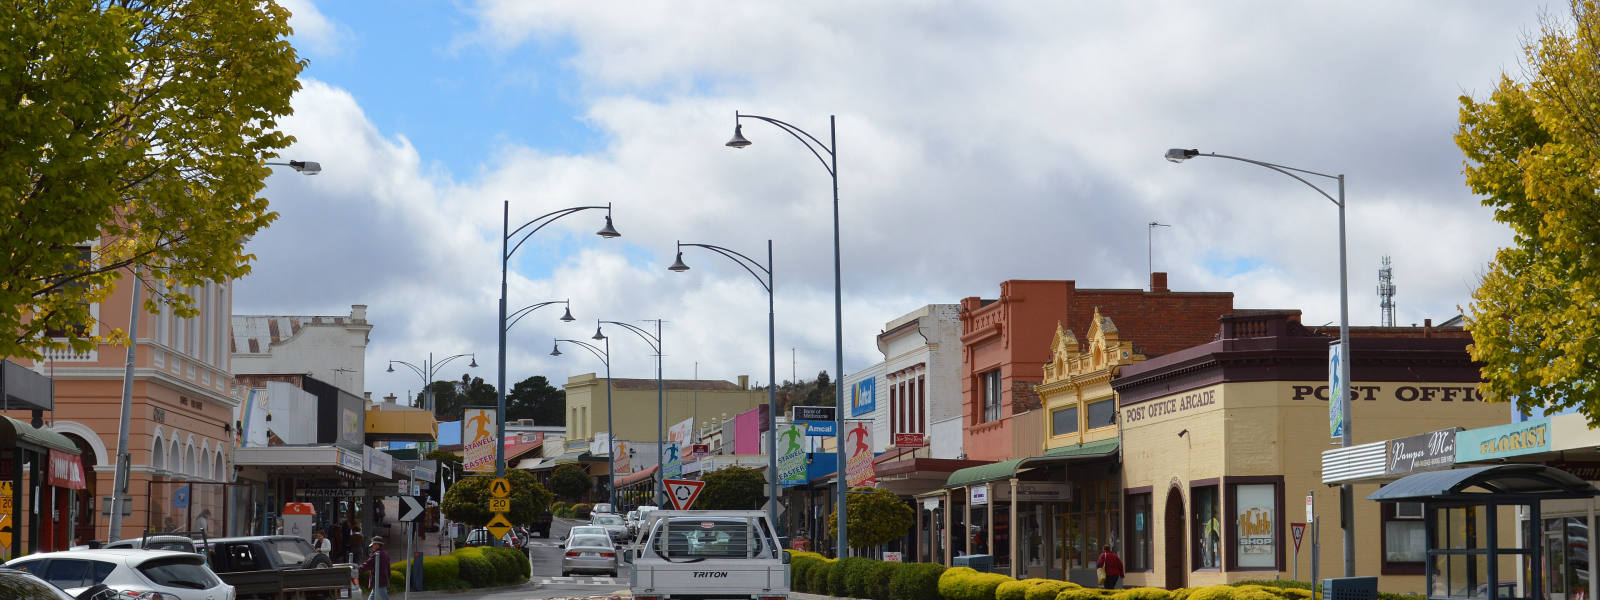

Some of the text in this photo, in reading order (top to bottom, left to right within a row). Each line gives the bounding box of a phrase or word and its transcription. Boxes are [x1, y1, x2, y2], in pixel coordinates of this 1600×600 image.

[1126, 389, 1216, 423] POST OFFICE ARCADE
[464, 435, 495, 452] STAWELL
[1480, 423, 1547, 455] FLORIST
[464, 454, 494, 471] EASTER
[778, 448, 805, 464] STAWELL
[778, 465, 806, 480] EASTER
[493, 499, 506, 508] 20
